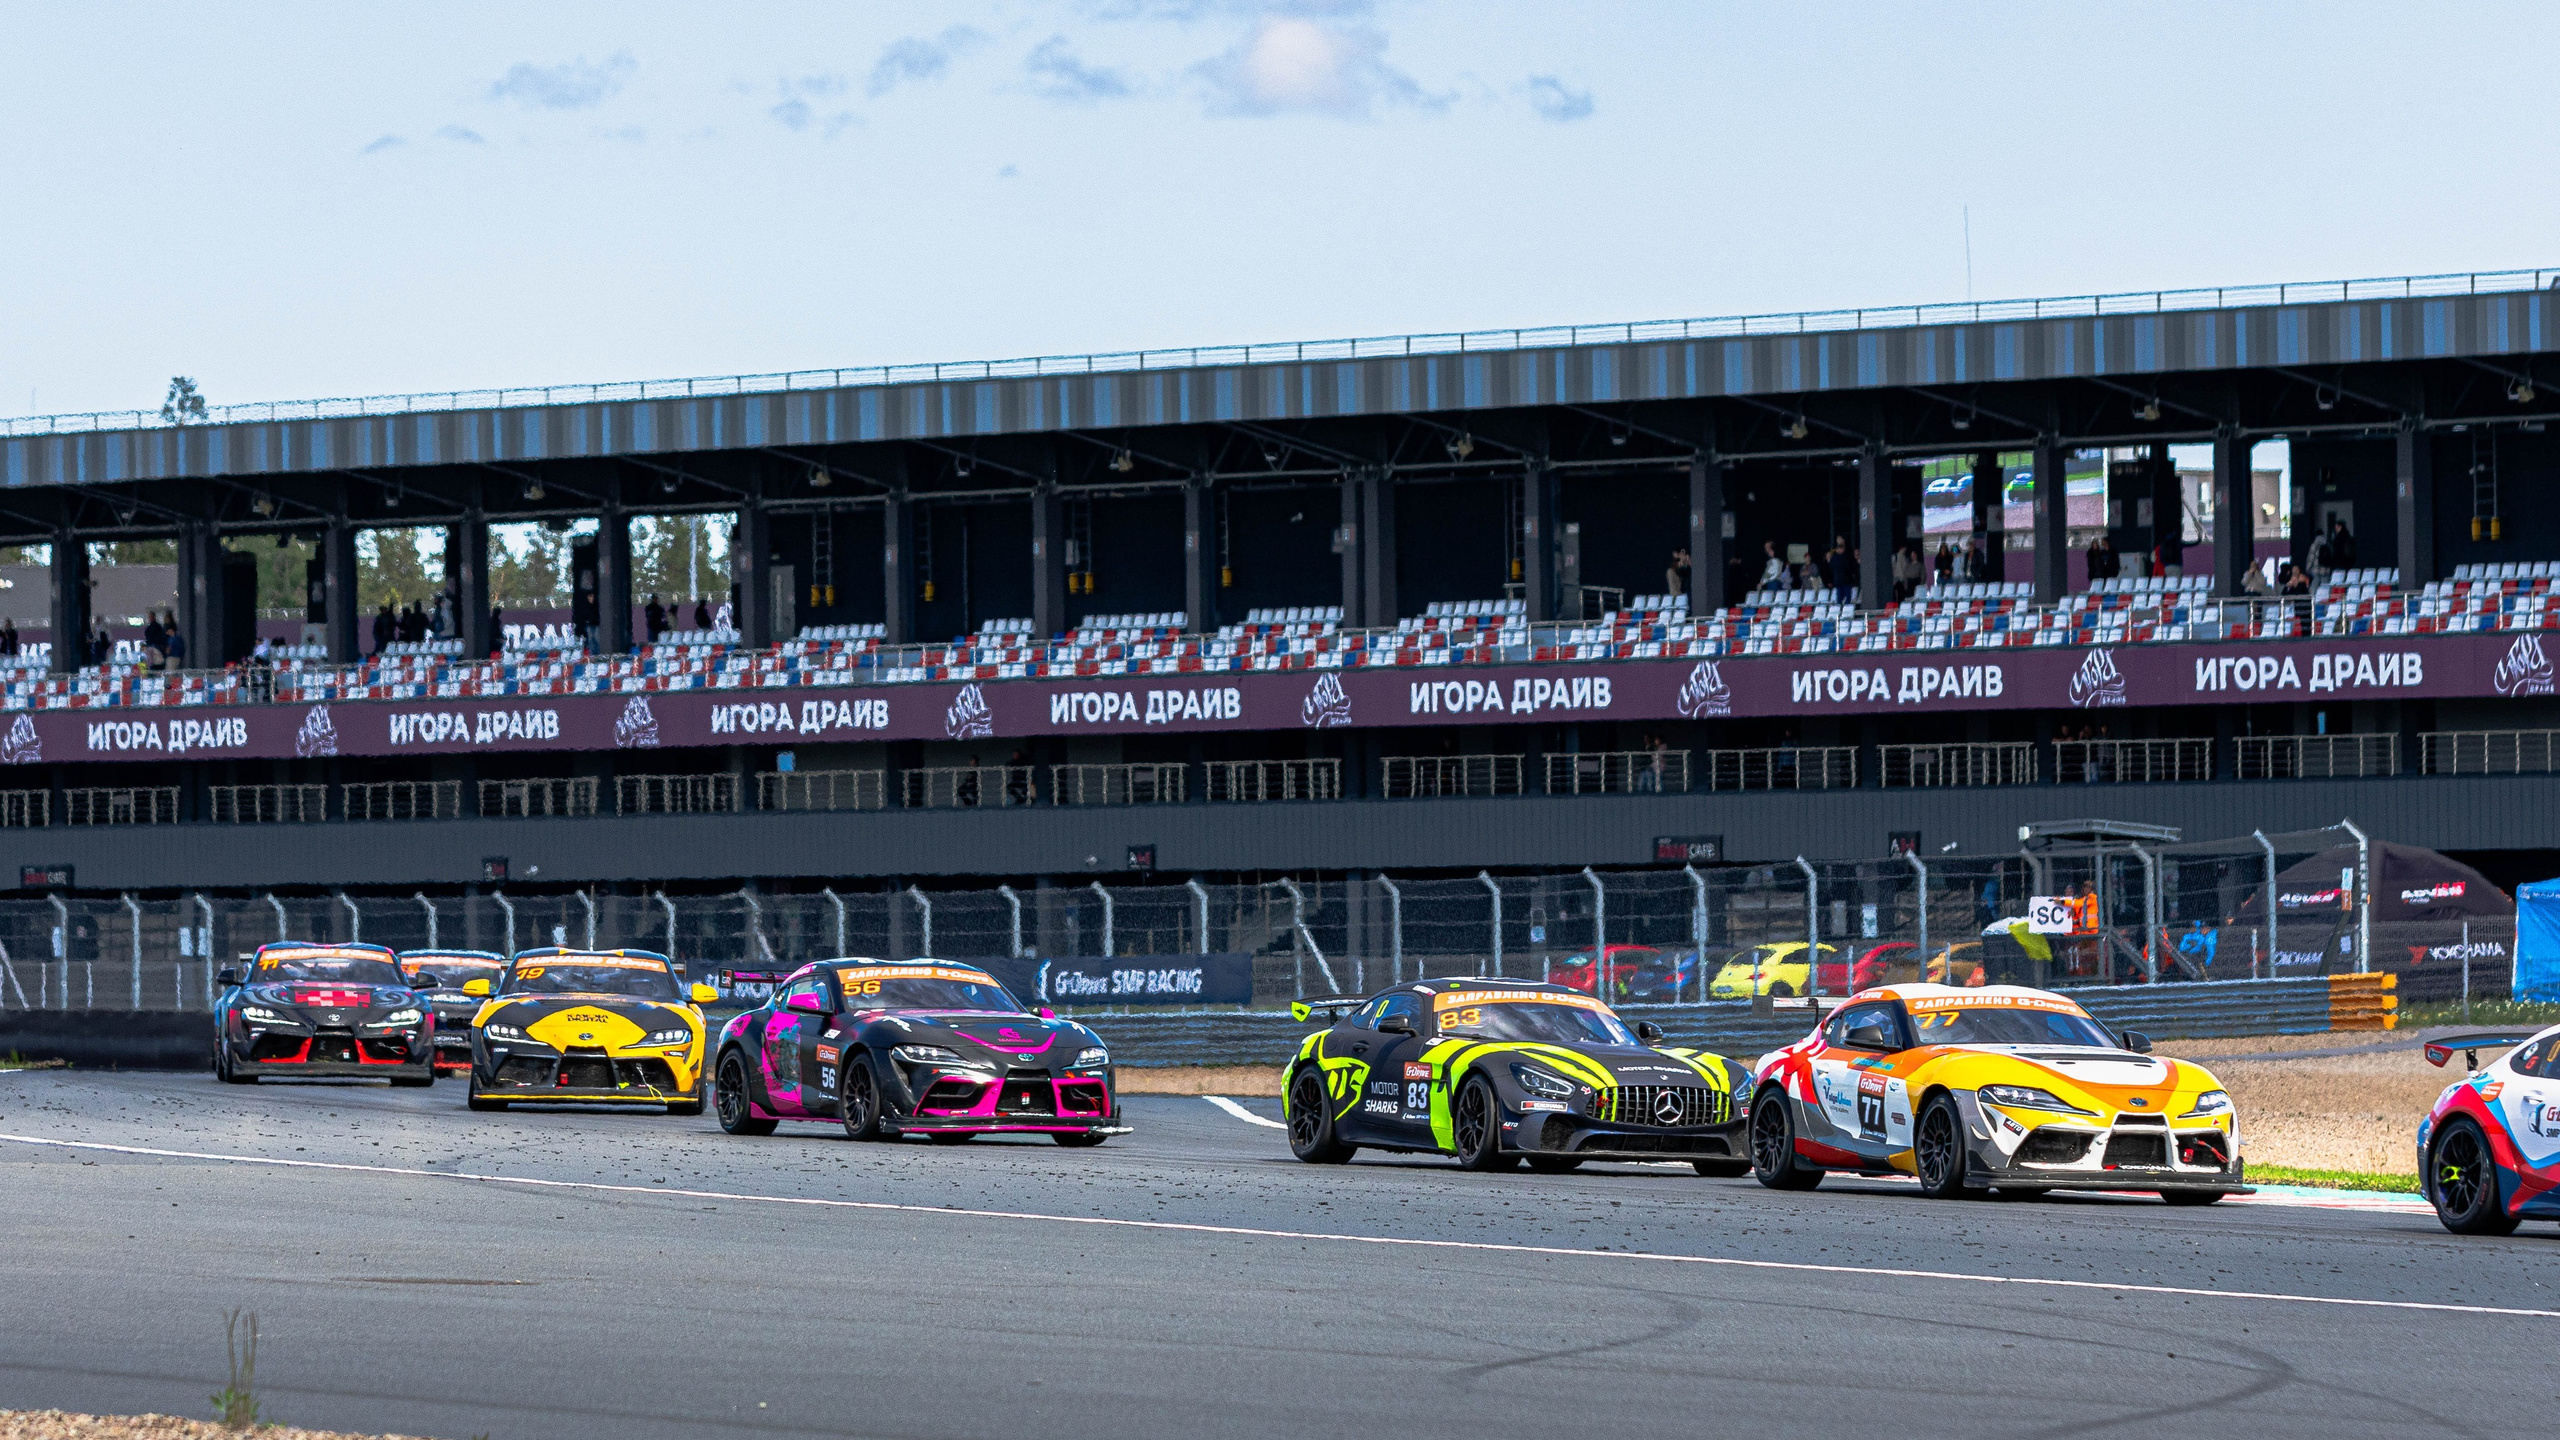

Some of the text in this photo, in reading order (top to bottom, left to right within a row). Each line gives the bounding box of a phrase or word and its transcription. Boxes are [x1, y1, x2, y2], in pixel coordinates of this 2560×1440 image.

[2196, 652, 2423, 693] ИГОРА ДРАЙВ
[1792, 665, 2003, 704] ИГОРА ДРАЙВ
[1051, 687, 1241, 724] ИГОРА ДРАЙВ
[1410, 677, 1612, 715] ИГОРА ДРАЙВ
[390, 712, 470, 744] ИГОРА
[711, 702, 795, 733] ИГОРА
[88, 721, 163, 751] ИГОРА
[2036, 905, 2065, 926] SC
[2429, 941, 2507, 961] YOKOHAMA
[258, 958, 279, 971] 11
[516, 967, 545, 980] 19
[847, 968, 933, 981] ЗАПРАВЛЕНО
[842, 980, 882, 996] 56
[1111, 969, 1143, 995] SMP
[1146, 968, 1203, 994] RACING
[1446, 990, 1537, 1004] ЗАПРАВЛЕНО
[1914, 996, 2012, 1010] ЗАПРАВЛЕНО
[1439, 1008, 1481, 1029] 83
[1915, 1010, 1961, 1030] 77
[821, 1066, 836, 1089] 56
[1370, 1080, 1400, 1097] MOTOR
[1407, 1082, 1428, 1109] 83
[1364, 1098, 1399, 1114] SHARKS
[1860, 1096, 1882, 1126] 77
